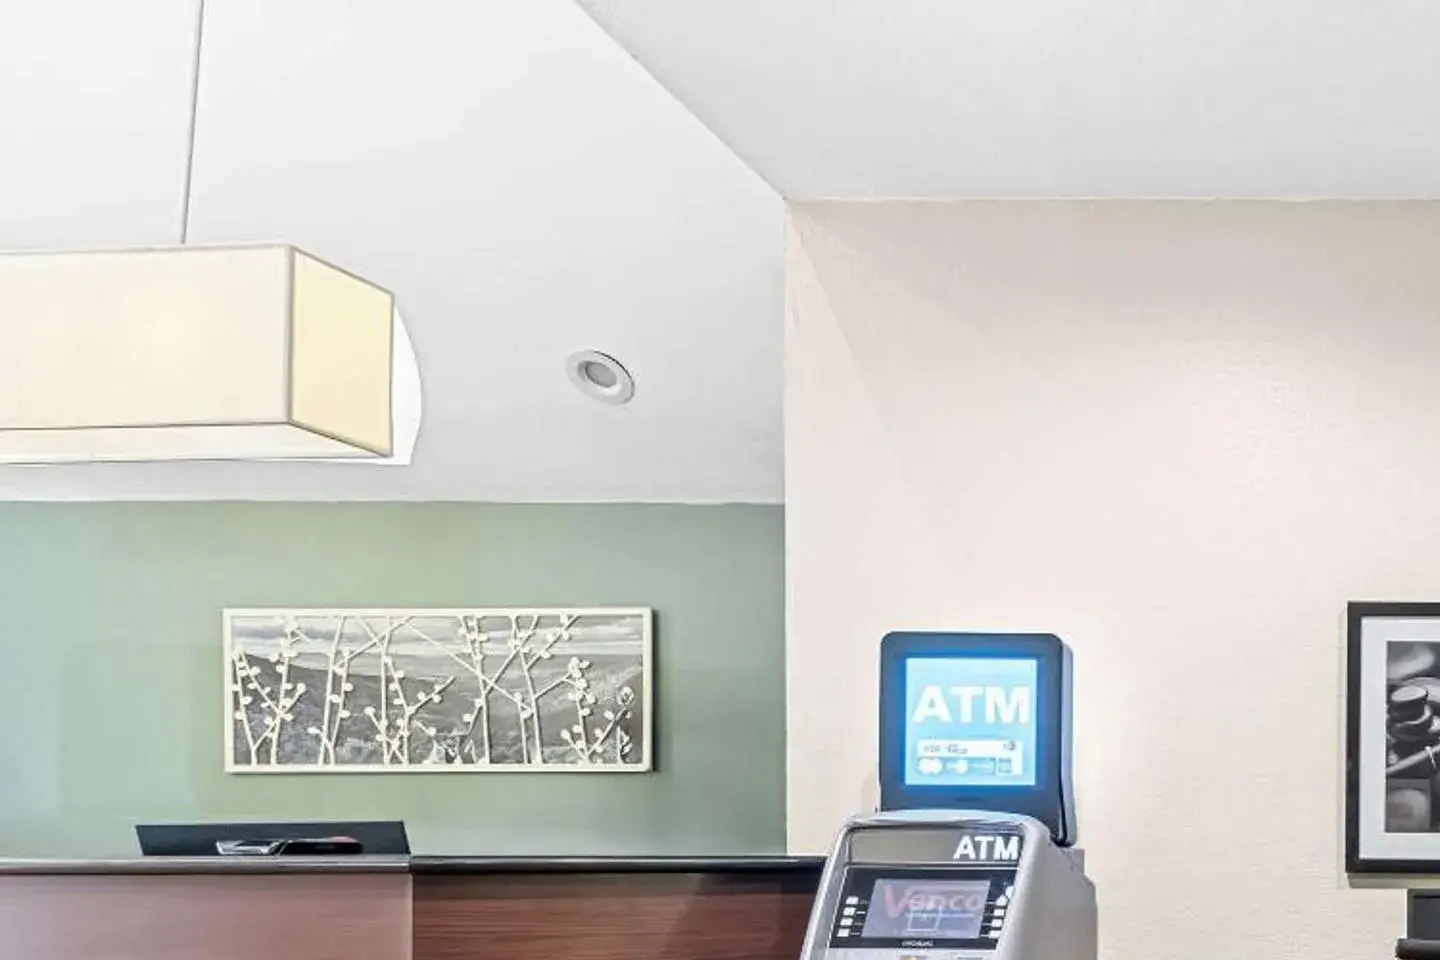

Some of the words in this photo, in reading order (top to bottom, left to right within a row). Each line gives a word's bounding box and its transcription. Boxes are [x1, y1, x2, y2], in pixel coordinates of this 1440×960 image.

[911, 685, 1030, 724] ATM
[953, 836, 1020, 860] ATM
[883, 884, 981, 917] Venco
